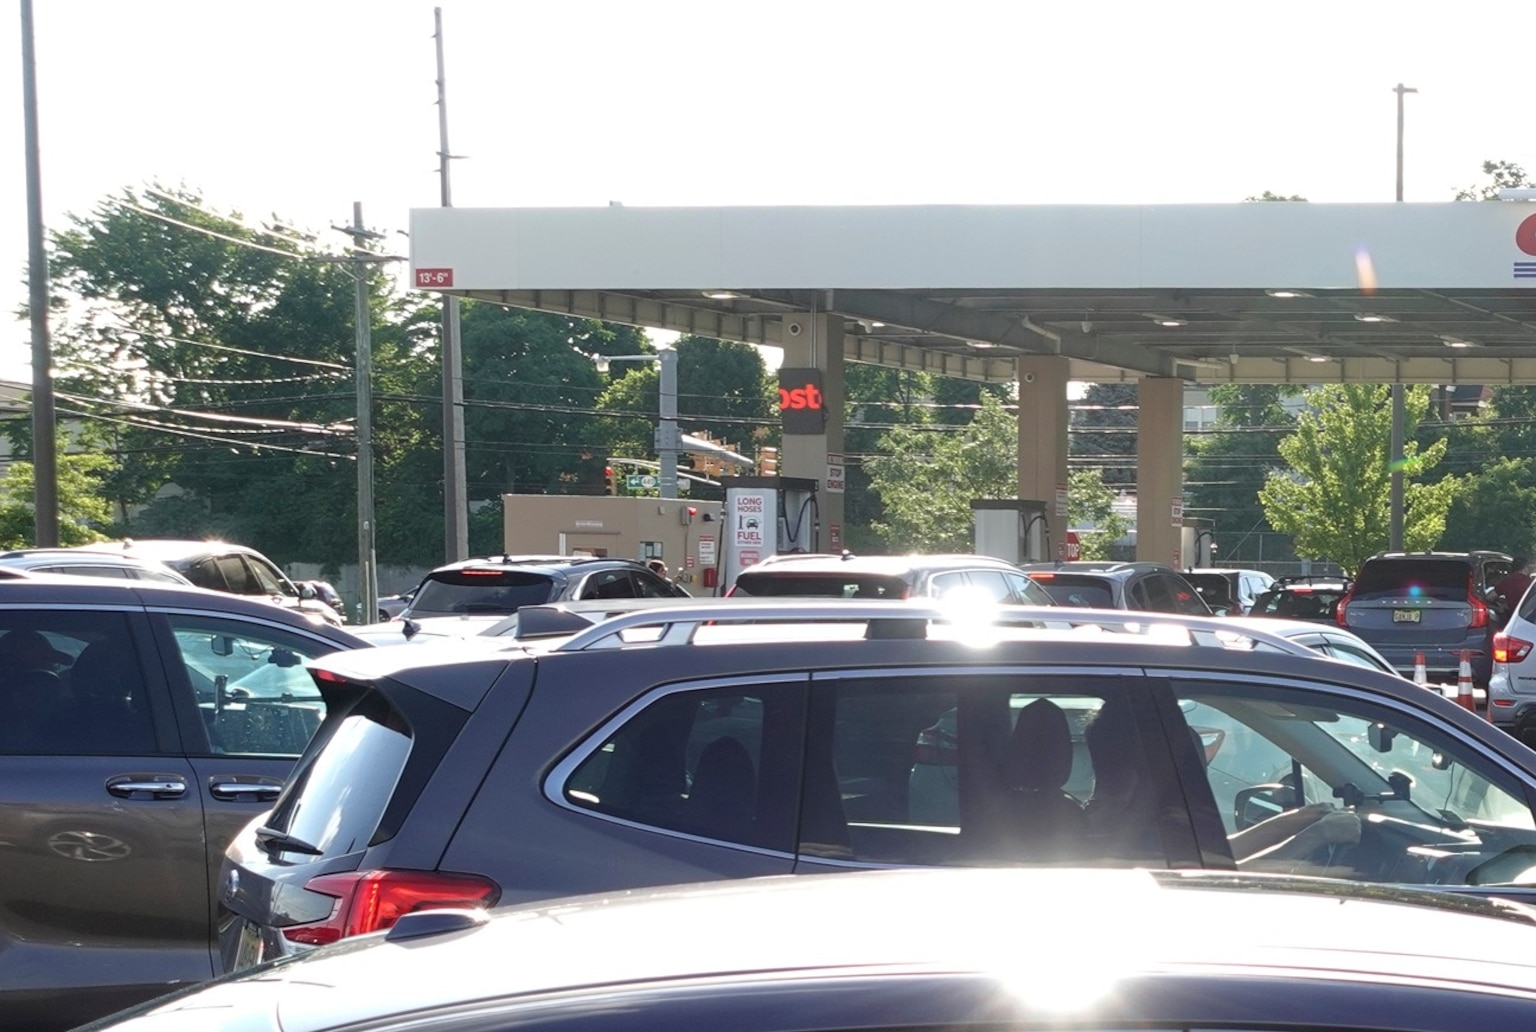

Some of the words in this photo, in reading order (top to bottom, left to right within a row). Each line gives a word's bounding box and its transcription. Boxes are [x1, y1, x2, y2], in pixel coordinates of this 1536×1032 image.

[737, 497, 762, 506] LONG
[737, 505, 762, 513] HOSES
[737, 531, 762, 540] FUEL
[1066, 543, 1080, 558] TOP
